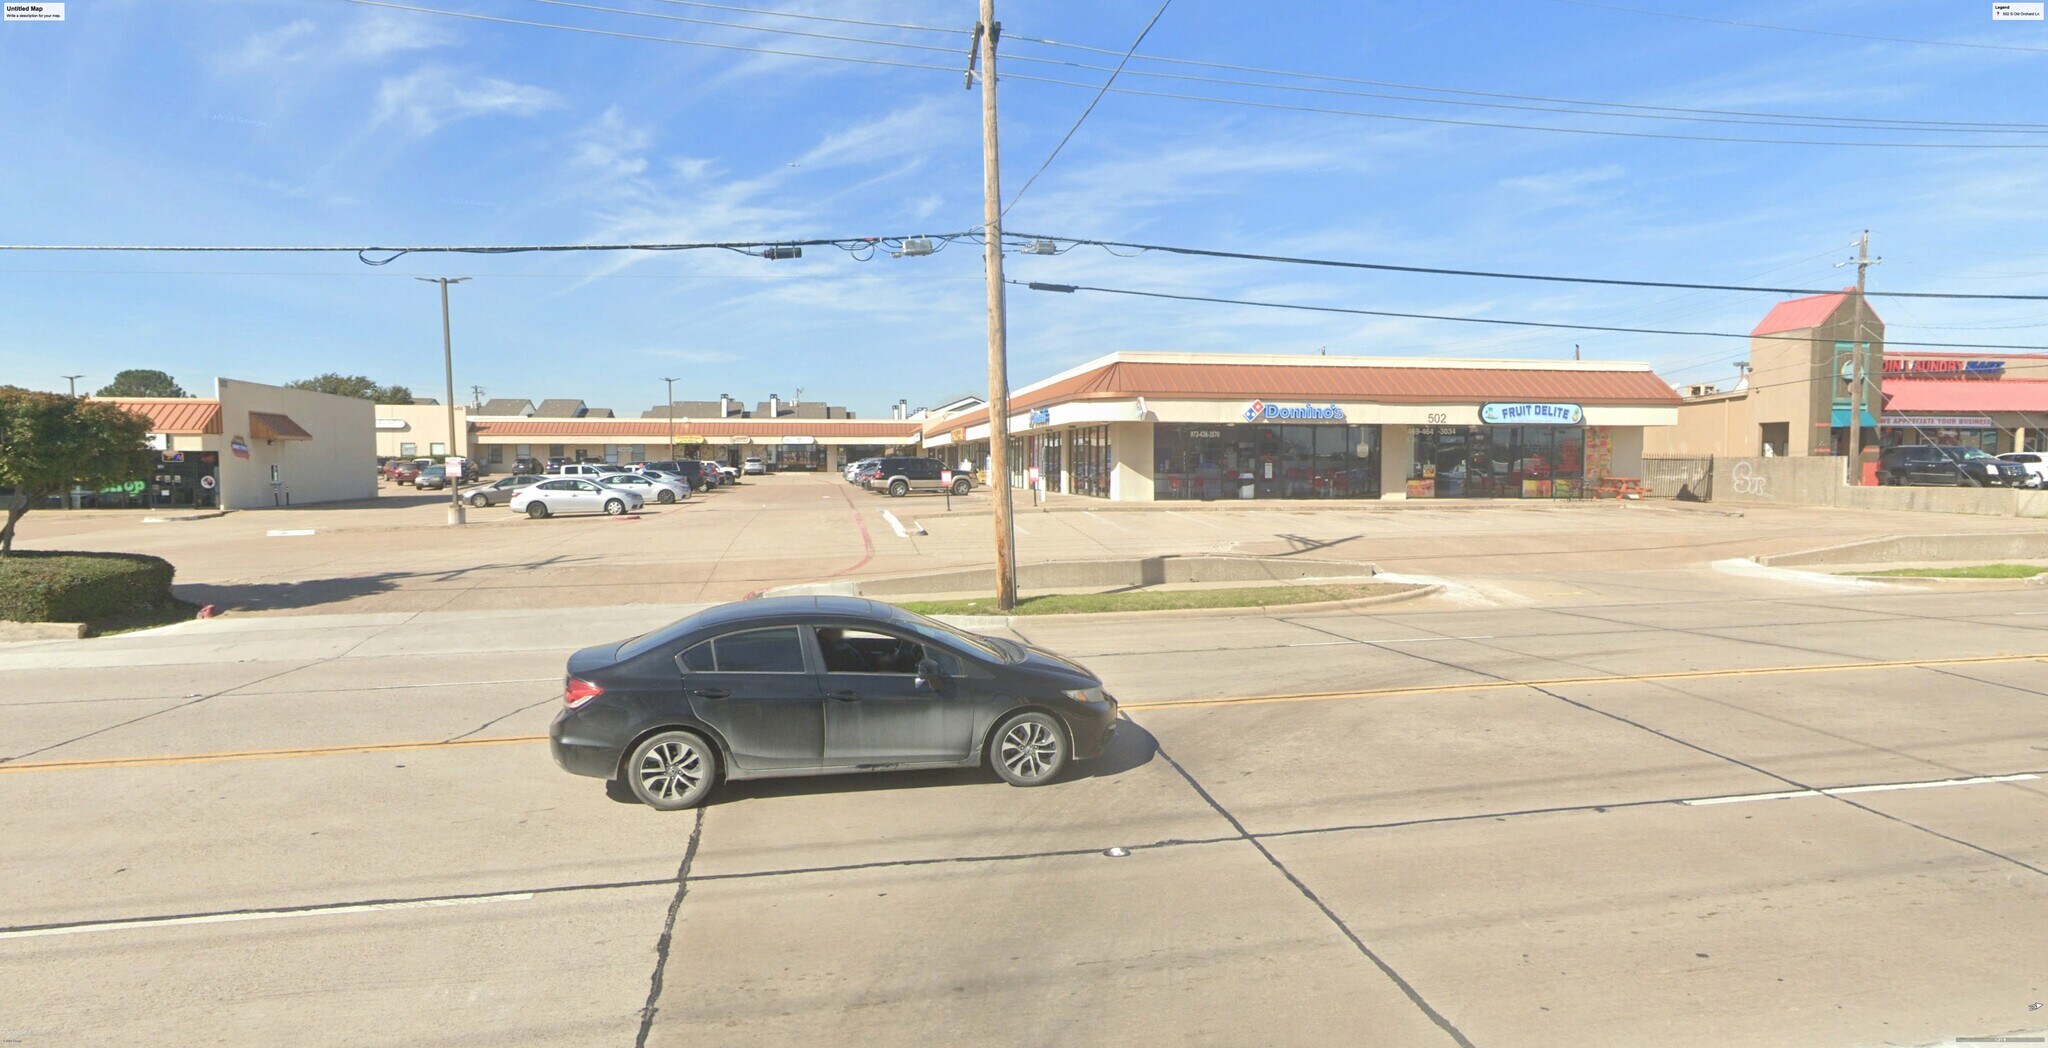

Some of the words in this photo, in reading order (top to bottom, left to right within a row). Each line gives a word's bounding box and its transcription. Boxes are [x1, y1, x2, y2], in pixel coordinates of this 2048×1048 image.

[1905, 360, 1964, 372] LAUNDRY
[1264, 403, 1344, 419] Domino's
[1502, 405, 1531, 419] FRUIT
[1534, 405, 1570, 419] DELITE
[1428, 413, 1447, 423] 502
